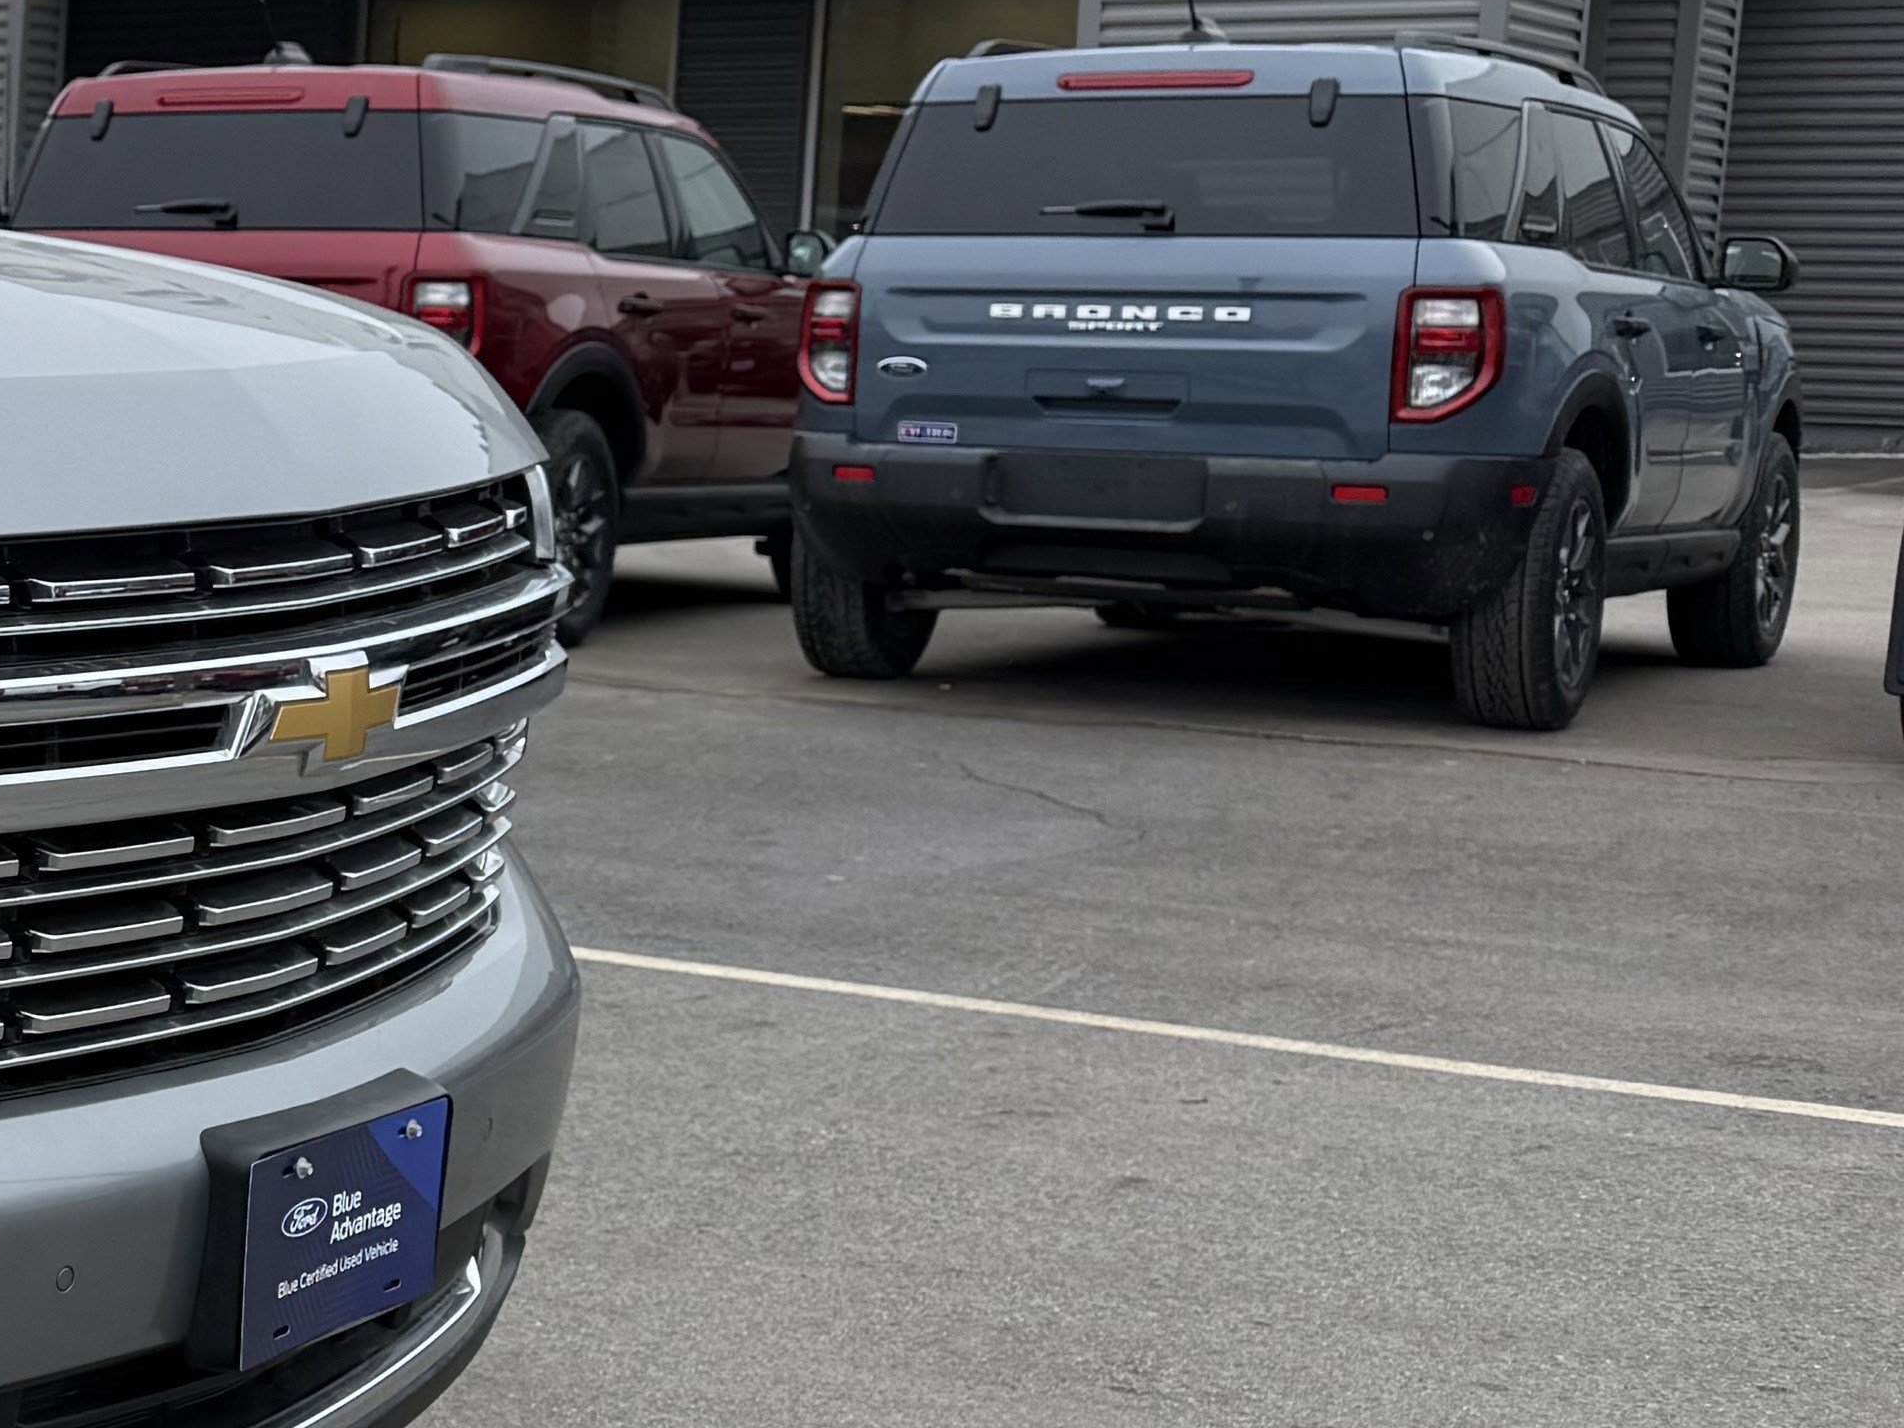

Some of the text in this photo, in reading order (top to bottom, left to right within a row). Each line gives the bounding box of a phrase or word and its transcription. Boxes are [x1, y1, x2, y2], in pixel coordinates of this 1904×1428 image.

[990, 303, 1251, 322] BRONCO
[1068, 320, 1164, 332] SPORT
[332, 1190, 362, 1217] Blue
[289, 1203, 320, 1233] Ford
[329, 1202, 402, 1245] Advantage
[277, 1237, 399, 1299] Blue Certified Used Vehicle
